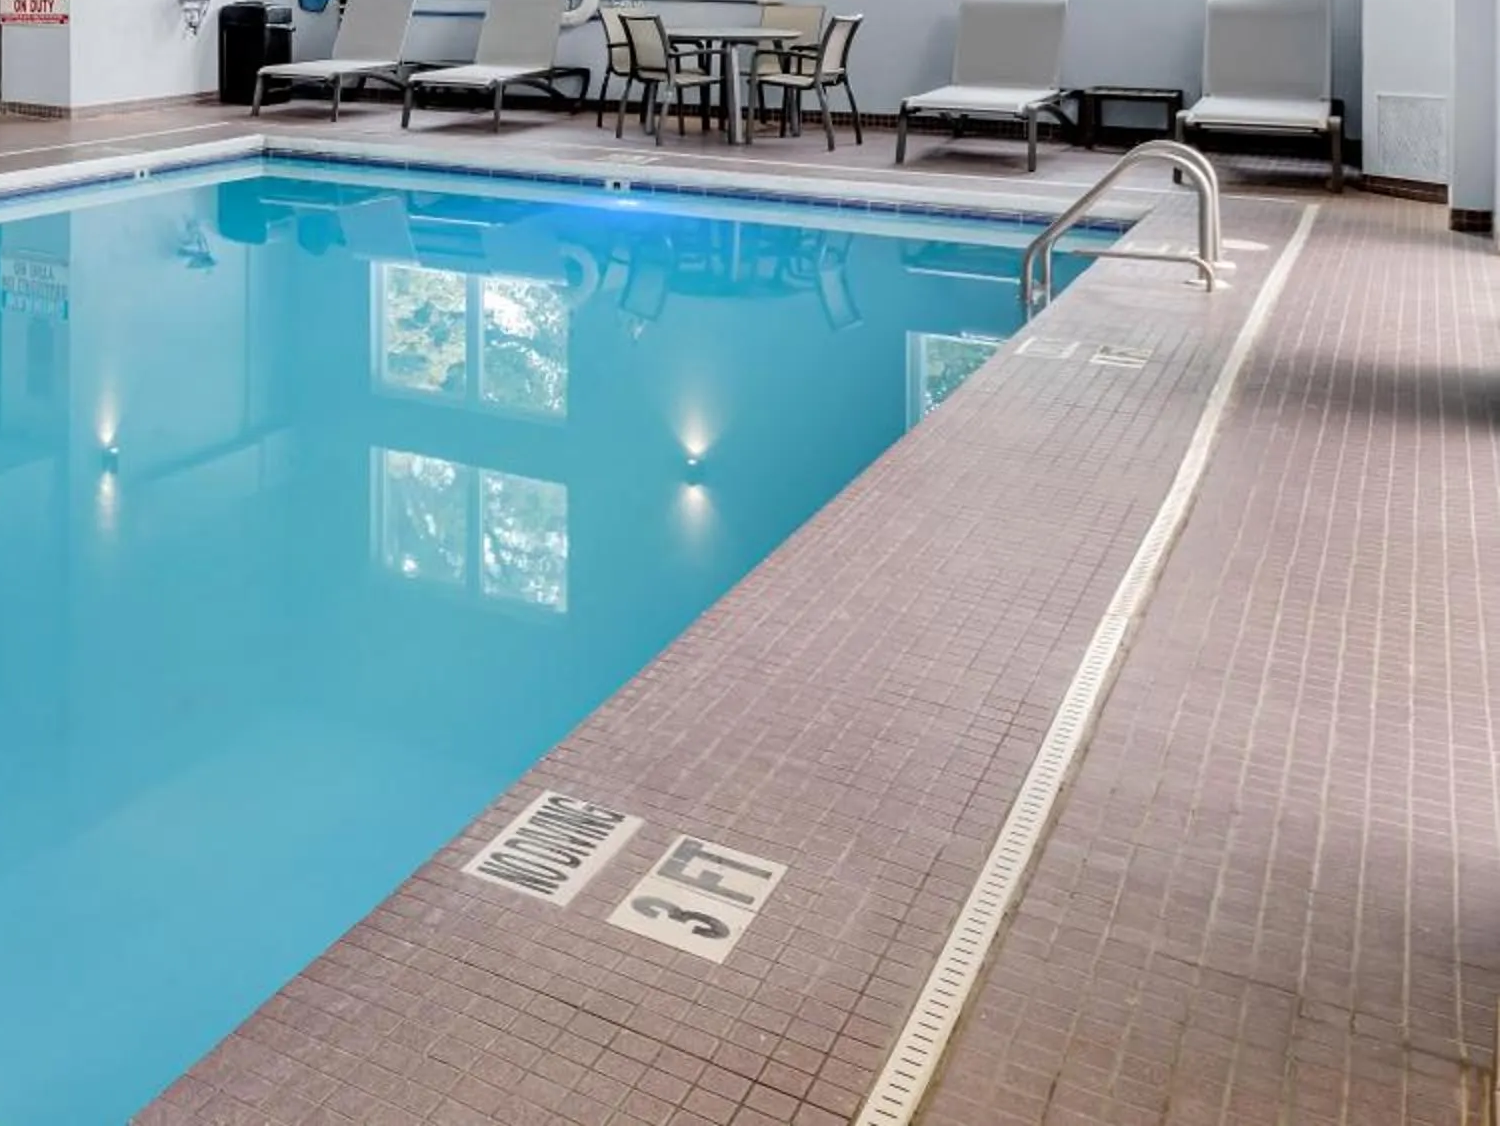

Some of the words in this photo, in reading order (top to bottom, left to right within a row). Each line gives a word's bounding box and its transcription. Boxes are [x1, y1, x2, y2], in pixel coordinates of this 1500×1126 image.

[503, 796, 626, 869] DIVING
[477, 851, 569, 895] NO
[656, 838, 773, 906] FT
[631, 895, 730, 940] 3
